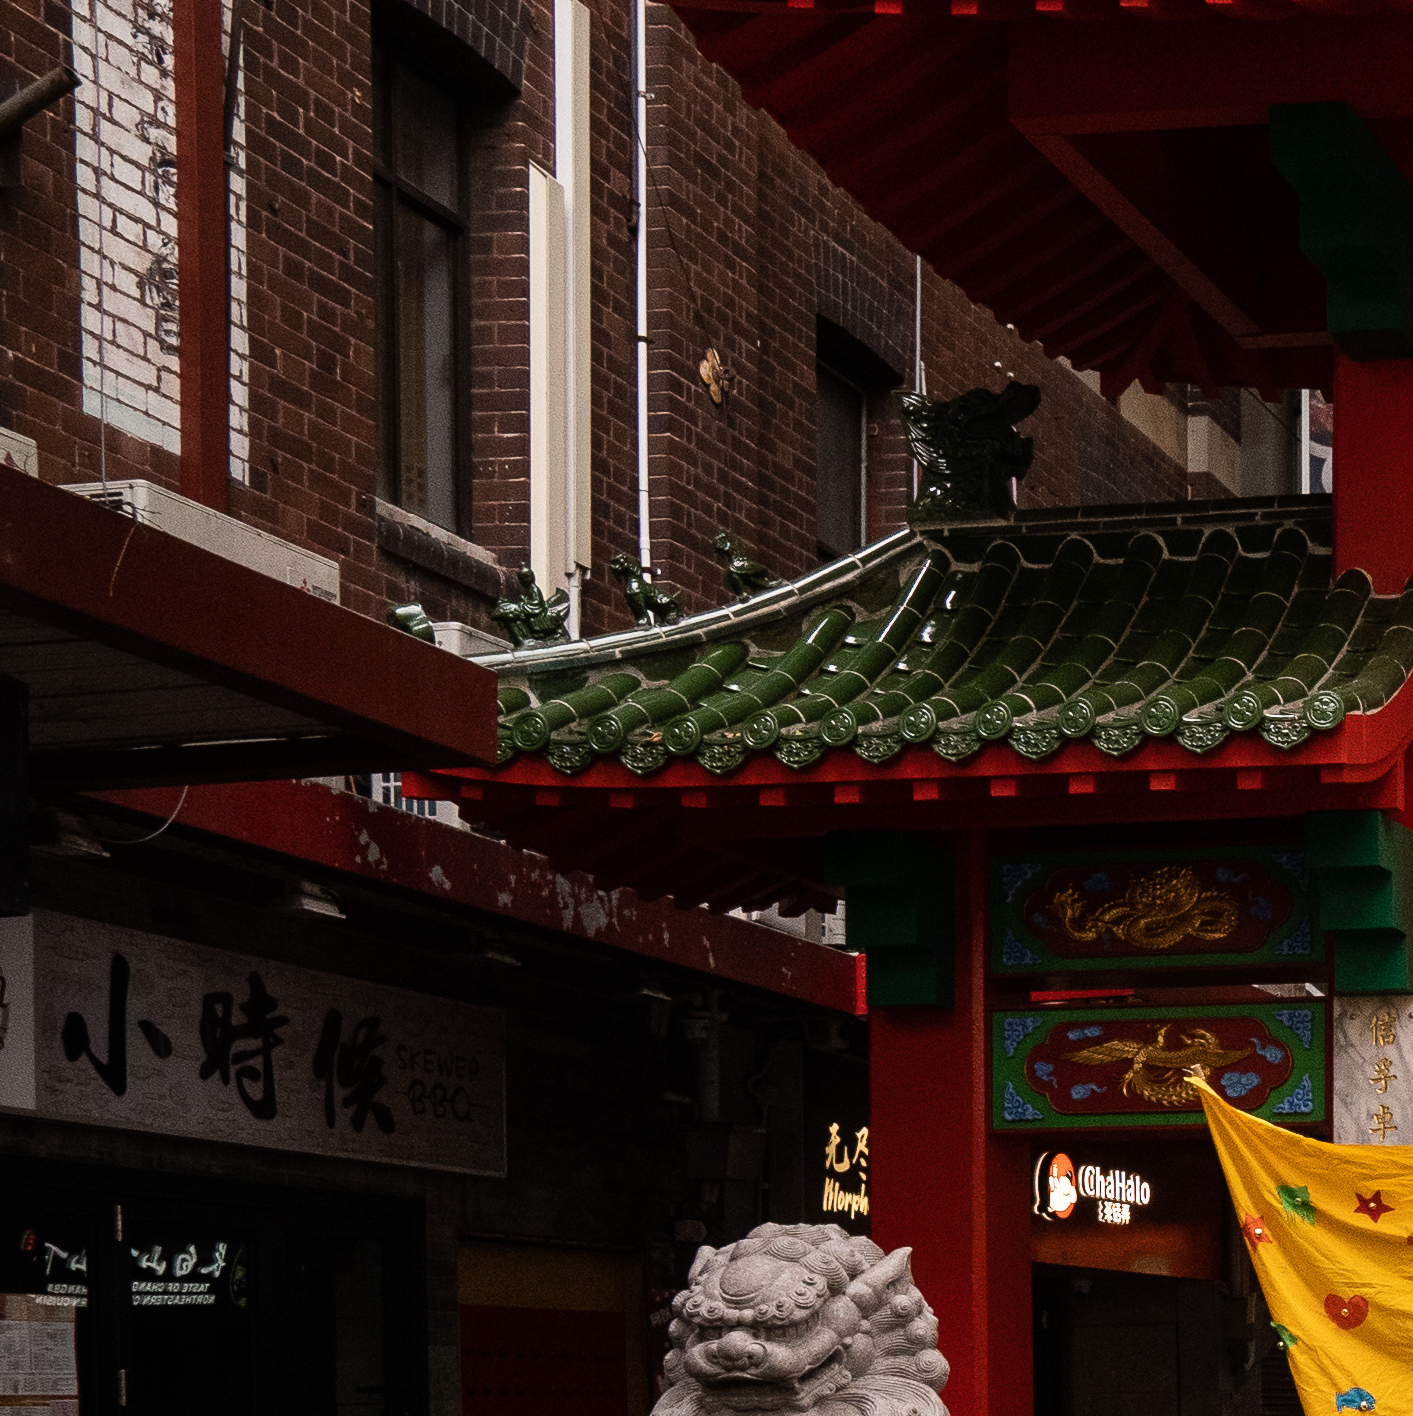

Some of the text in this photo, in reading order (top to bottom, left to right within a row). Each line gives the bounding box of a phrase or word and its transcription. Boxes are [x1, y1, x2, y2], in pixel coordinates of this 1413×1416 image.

[61, 951, 397, 1135] 小時候
[395, 1043, 483, 1082] SKEWER
[405, 1079, 478, 1123] BBQ
[1082, 1165, 1151, 1205] ChaHalo
